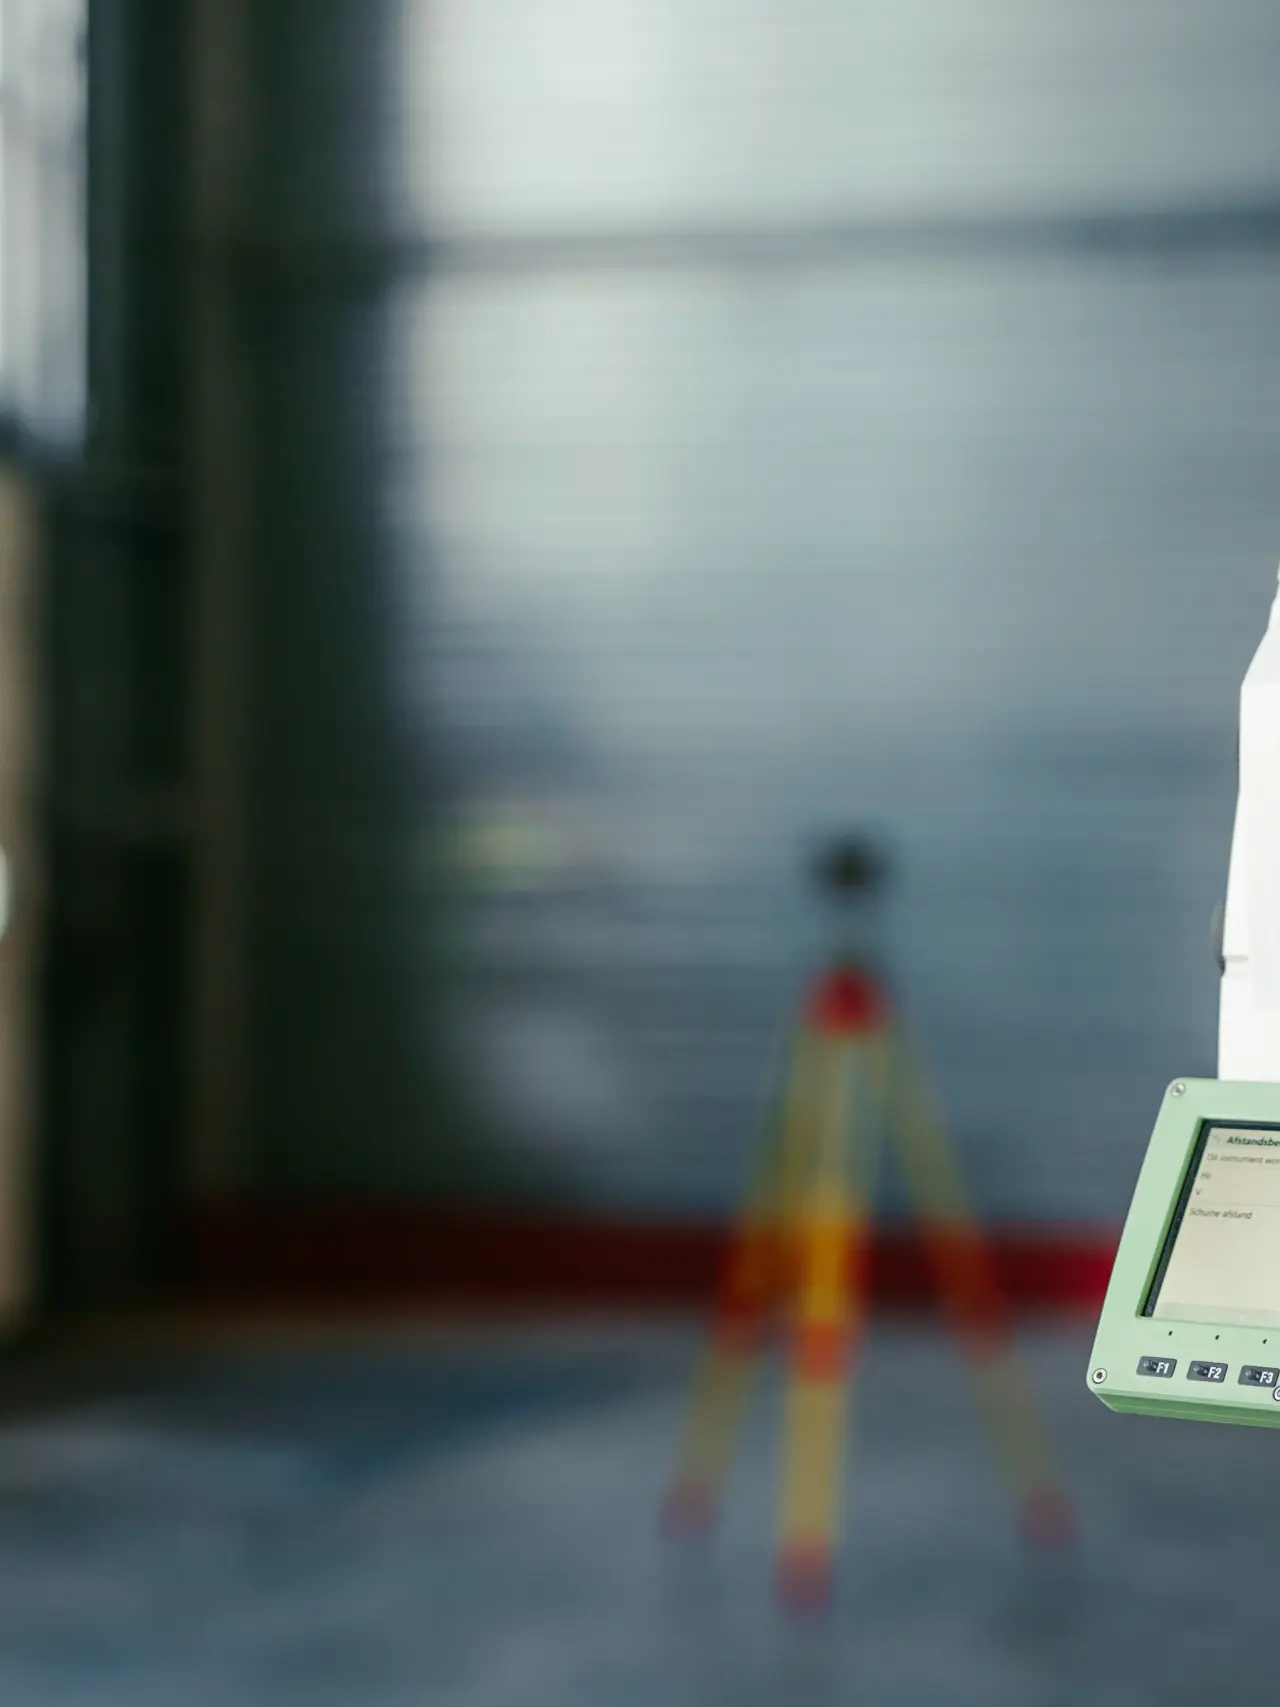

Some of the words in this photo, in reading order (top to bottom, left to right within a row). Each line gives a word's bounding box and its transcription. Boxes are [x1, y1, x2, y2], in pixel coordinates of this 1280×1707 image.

[1156, 1361, 1169, 1374] F1
[1207, 1366, 1222, 1379] F2
[1259, 1371, 1274, 1384] F3
